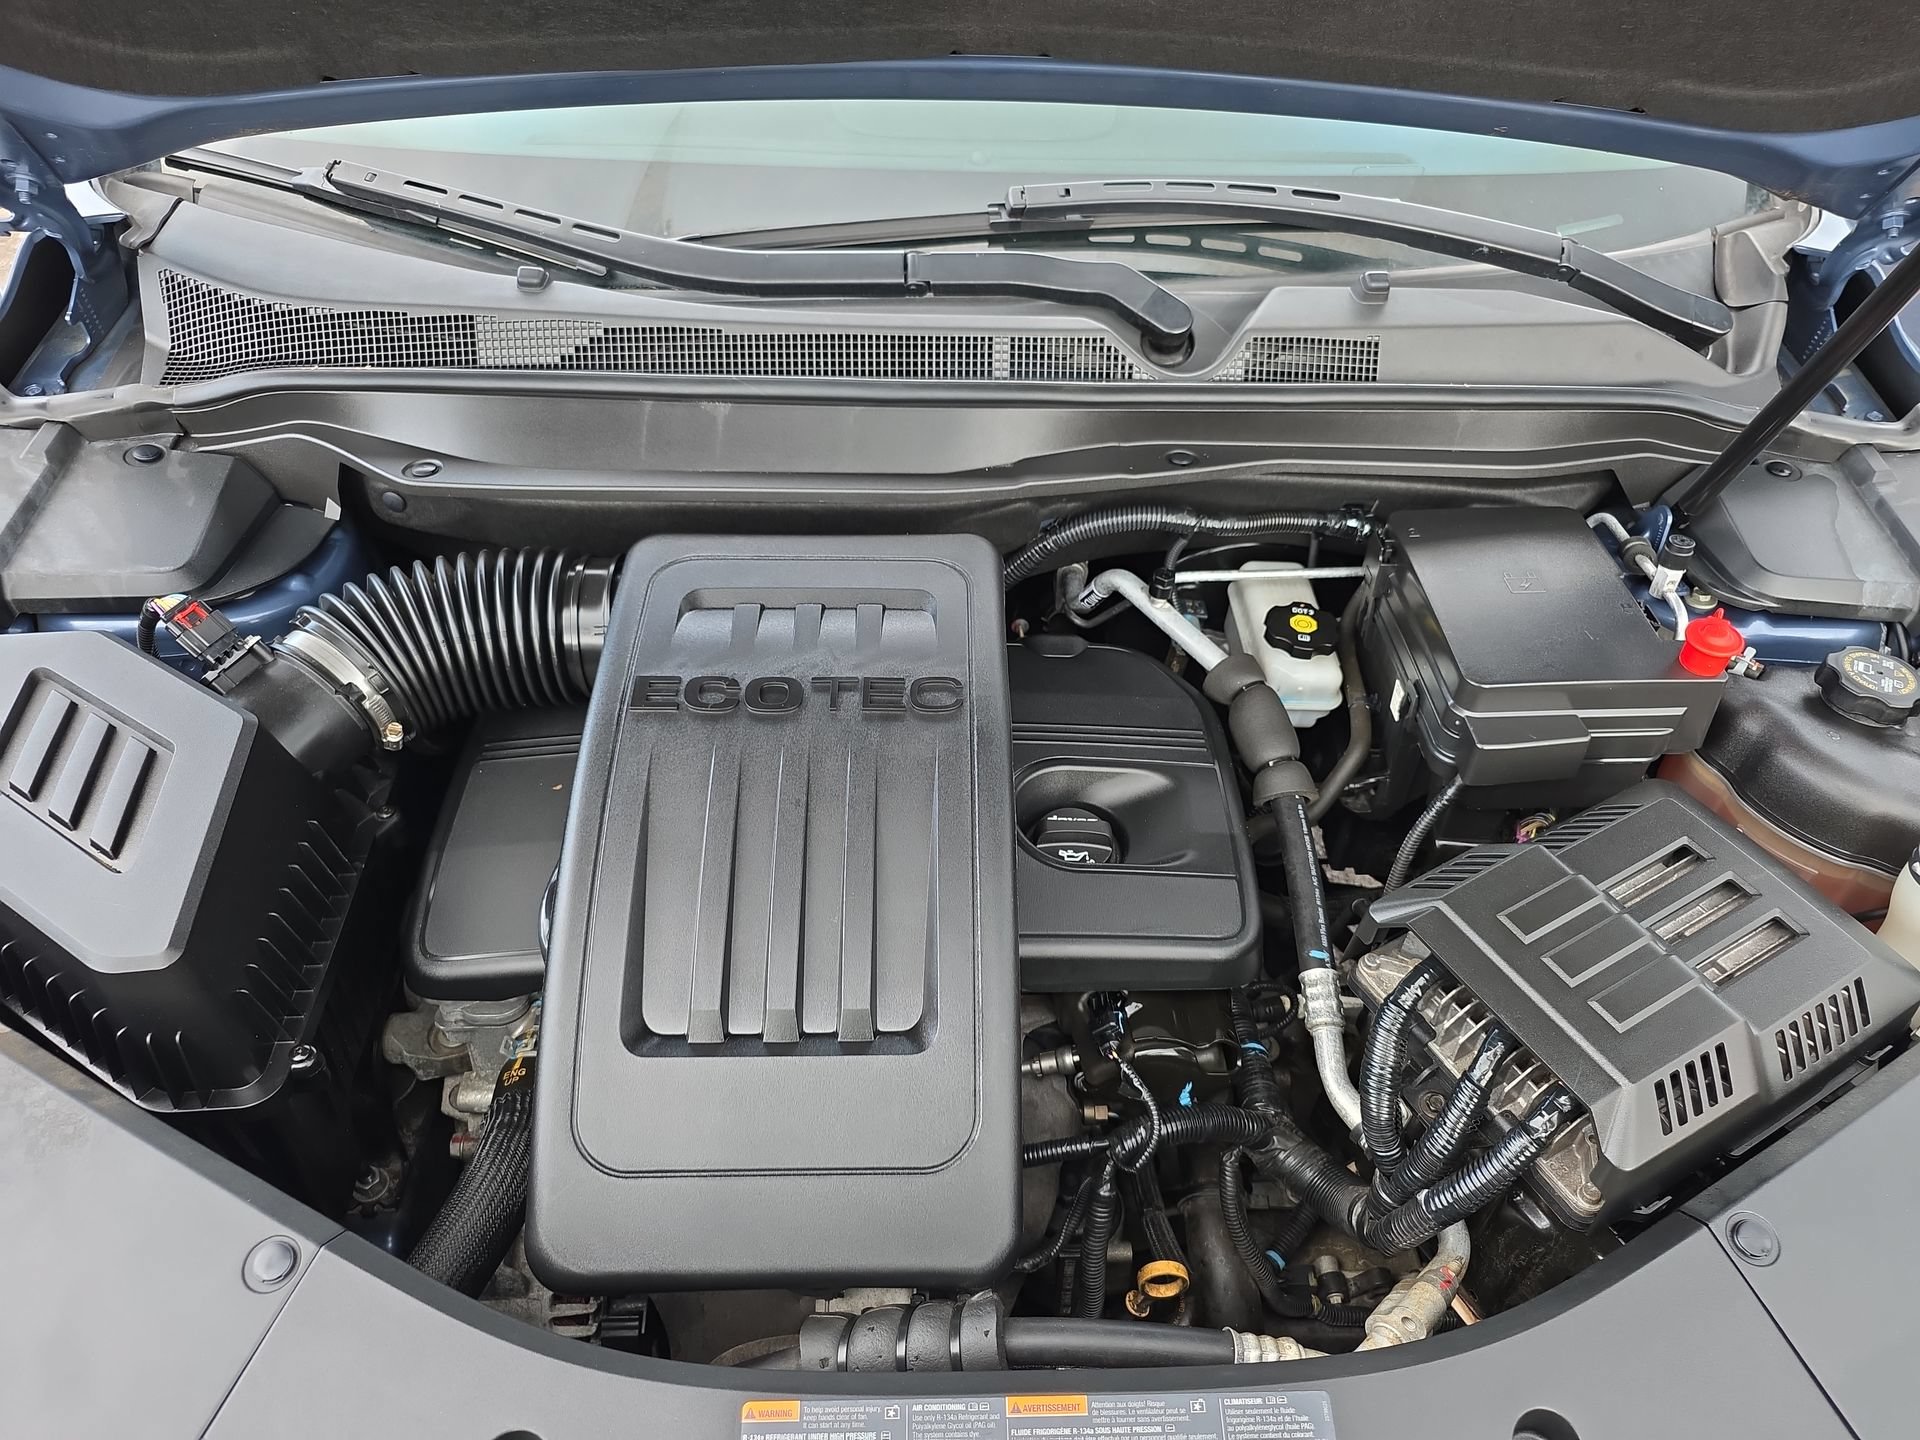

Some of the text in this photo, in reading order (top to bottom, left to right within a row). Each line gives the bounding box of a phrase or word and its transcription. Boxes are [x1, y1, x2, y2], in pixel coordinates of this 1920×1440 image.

[629, 676, 964, 714] ECOTEC
[1308, 851, 1317, 875] SUCTION
[503, 1068, 526, 1080] ENG
[504, 1076, 519, 1086] UP
[840, 1405, 864, 1413] personal
[924, 1403, 966, 1411] CONDITIONING
[1023, 1403, 1080, 1412] AVERTISSEMENT
[758, 1410, 792, 1418] WARNING
[924, 1414, 935, 1422] only
[912, 1422, 946, 1430] Polyalkylene
[1033, 1427, 1072, 1435] FRIGORIGÈNE
[846, 1432, 876, 1440] PRESSURE
[924, 1432, 944, 1440] system
